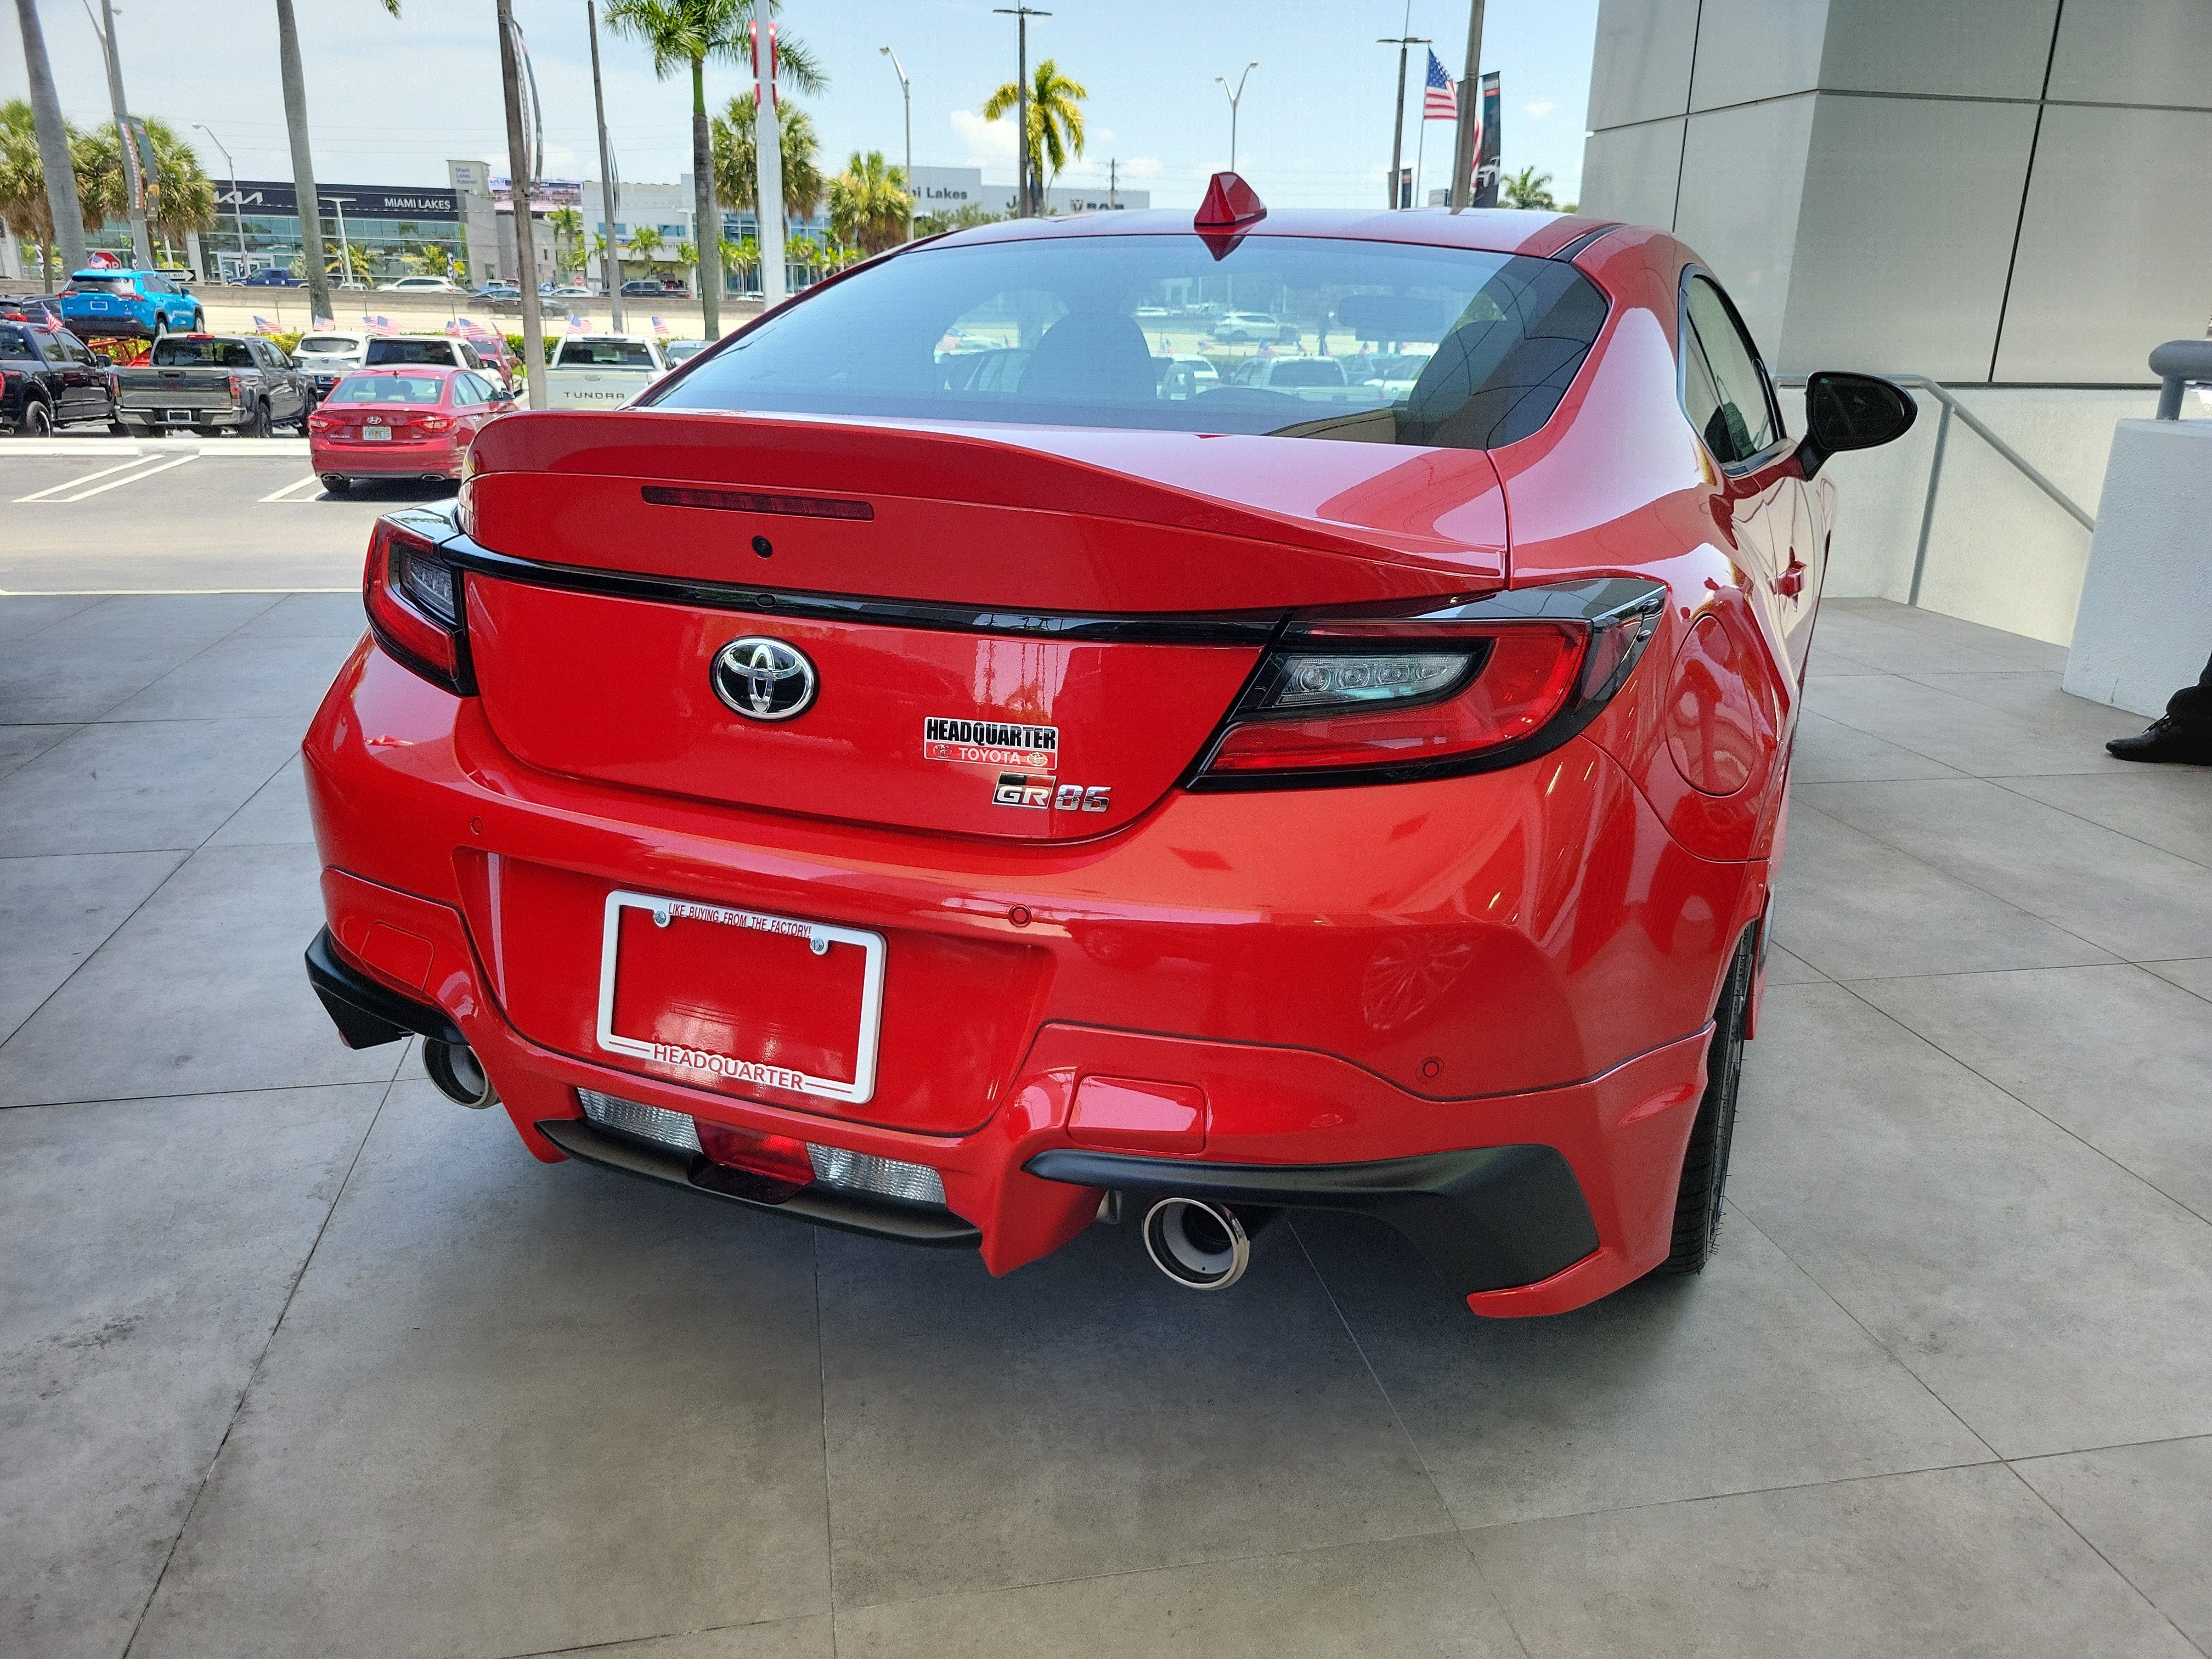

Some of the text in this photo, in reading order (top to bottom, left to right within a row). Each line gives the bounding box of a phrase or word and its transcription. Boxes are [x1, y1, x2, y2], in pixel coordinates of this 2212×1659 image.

[385, 198, 451, 209] MIAMI LAKES
[927, 187, 968, 199] Lakes
[927, 719, 1056, 749] HEADQUARTER
[958, 747, 1022, 764] TOYOTA
[996, 785, 1111, 812] GR 86
[668, 902, 812, 937] LIKE BUYING FROM THE FACTORY!
[653, 1045, 803, 1090] HEADQUARTER
